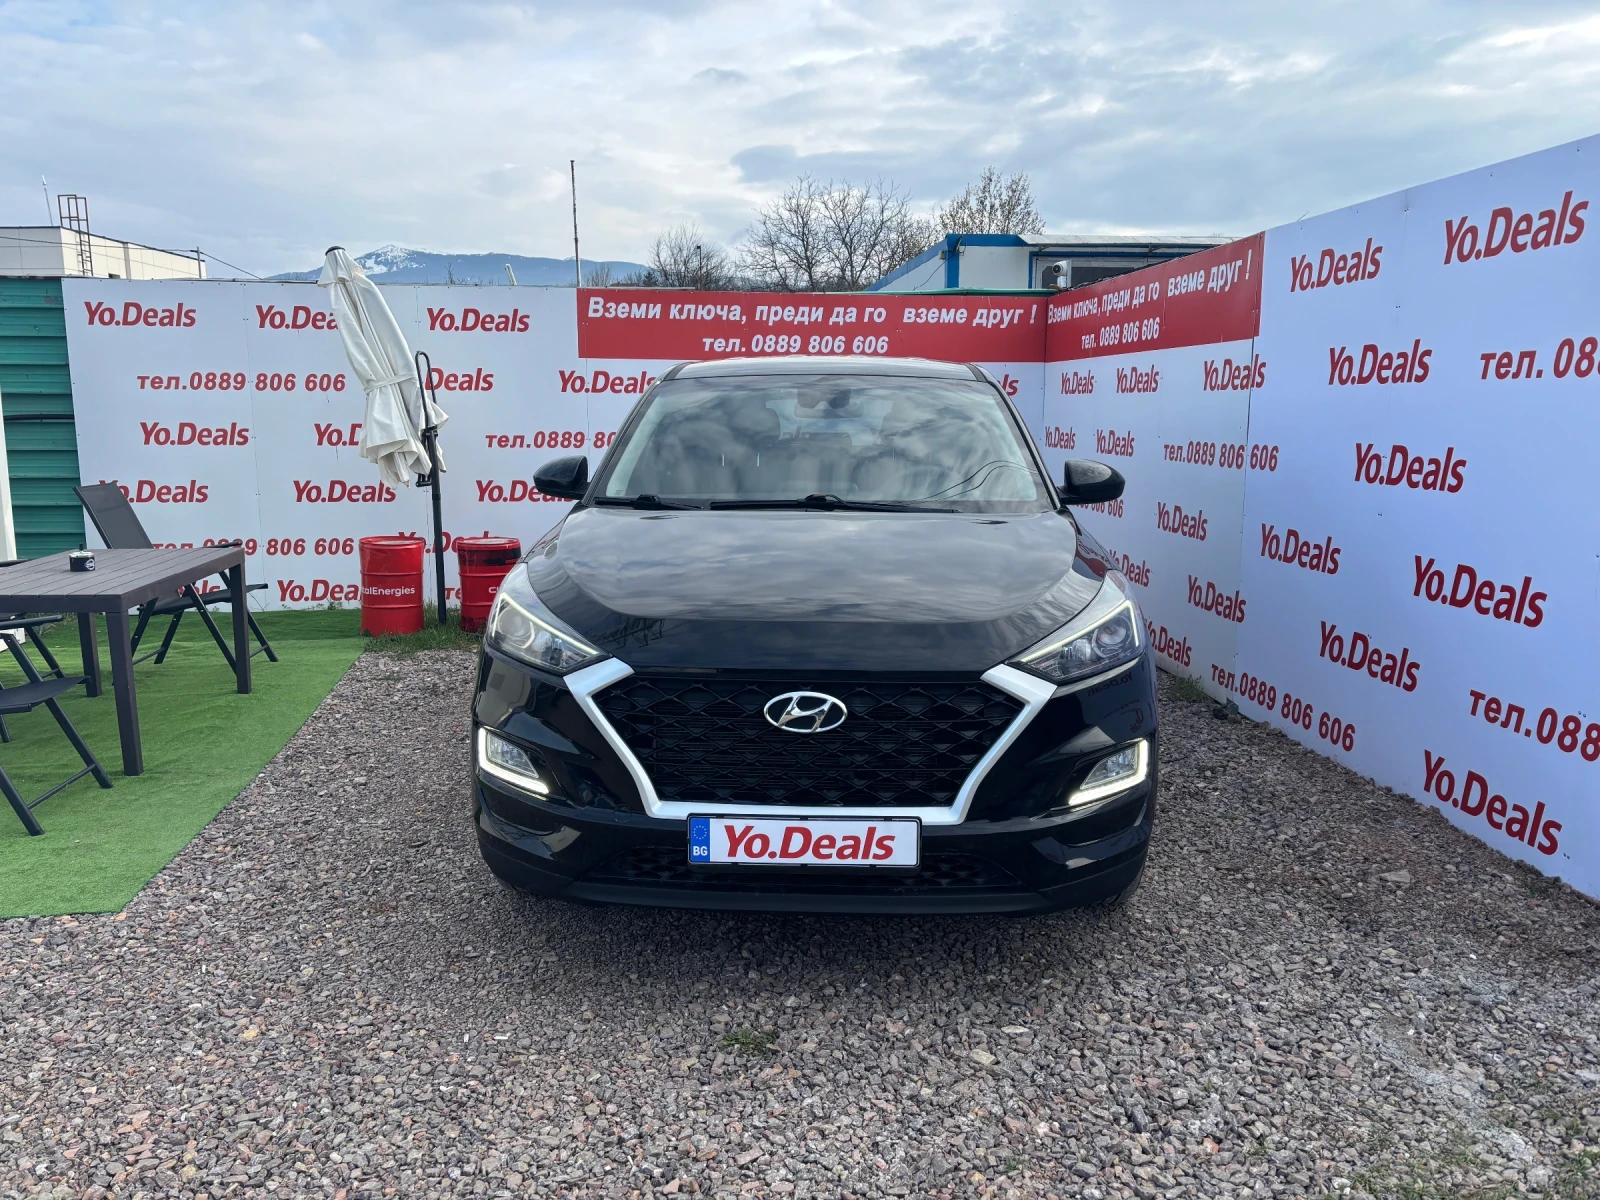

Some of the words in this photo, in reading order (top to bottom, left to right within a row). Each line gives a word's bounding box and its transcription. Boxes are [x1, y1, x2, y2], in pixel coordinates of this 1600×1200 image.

[1444, 191, 1589, 264] Yo.Deals
[1291, 238, 1383, 292] Yo.Deals
[1048, 304, 1071, 323] Вземи
[1074, 297, 1100, 318] ключа,
[1102, 289, 1130, 316] преди
[1132, 285, 1145, 305] да
[1148, 281, 1159, 301] го
[1168, 270, 1205, 297] вземе
[1207, 260, 1243, 293] друг
[85, 302, 196, 328] Yo.Deals
[256, 305, 338, 330] Yo.Dea
[427, 308, 530, 332] Yo.Deals
[588, 297, 662, 318] Вземи
[669, 304, 746, 324] ключа,
[755, 306, 823, 326] преди
[829, 307, 857, 325] да
[864, 308, 887, 323] го
[903, 308, 967, 324] вземе
[973, 308, 1024, 328] друг
[702, 338, 746, 351] тел.
[751, 335, 801, 353] 0889
[808, 336, 845, 353] 806
[852, 336, 889, 353] 606
[1081, 334, 1096, 349] тел.
[1100, 325, 1120, 346] 0889
[1122, 321, 1139, 344] 806
[1142, 317, 1160, 340] 606
[1204, 354, 1266, 391] Yo.Deals
[1329, 339, 1432, 386] Yo.Deals
[1481, 350, 1544, 380] тел.
[1553, 337, 1600, 378] 08
[138, 372, 246, 391] тел.0889
[255, 373, 296, 392] 806
[305, 373, 346, 392] 606
[424, 368, 494, 391] Deals
[1060, 370, 1095, 395] Yo.Deals
[1117, 365, 1160, 394] Yo.Deals
[140, 422, 249, 446] Yo.Deals
[486, 431, 586, 449] тел.0889
[1045, 426, 1076, 450] Yo.Deals
[1096, 429, 1135, 457] Yo.Deals
[1164, 441, 1216, 466] тел.0889
[1219, 444, 1245, 470] 806
[1250, 444, 1279, 472] 606
[1355, 443, 1467, 493] Yo.Deals
[294, 480, 396, 503] Yo.Deals
[1158, 502, 1208, 541] Yo.Deals
[266, 538, 306, 556] 806
[314, 538, 354, 556] 606
[1261, 524, 1341, 575] Yo.Deals
[278, 579, 360, 602] Yo.Dea
[362, 585, 415, 597] talEnergies
[1188, 575, 1246, 623] Yo.Deals
[1414, 556, 1547, 628] Yo.Deals
[1320, 621, 1420, 692] Yo.Deals
[1211, 664, 1277, 710] тел.0889
[1281, 693, 1313, 730] 806
[1318, 712, 1356, 752] 606
[1424, 750, 1562, 855] Yo.Deals
[692, 846, 708, 857] BG
[724, 825, 896, 860] Yo.Deals
